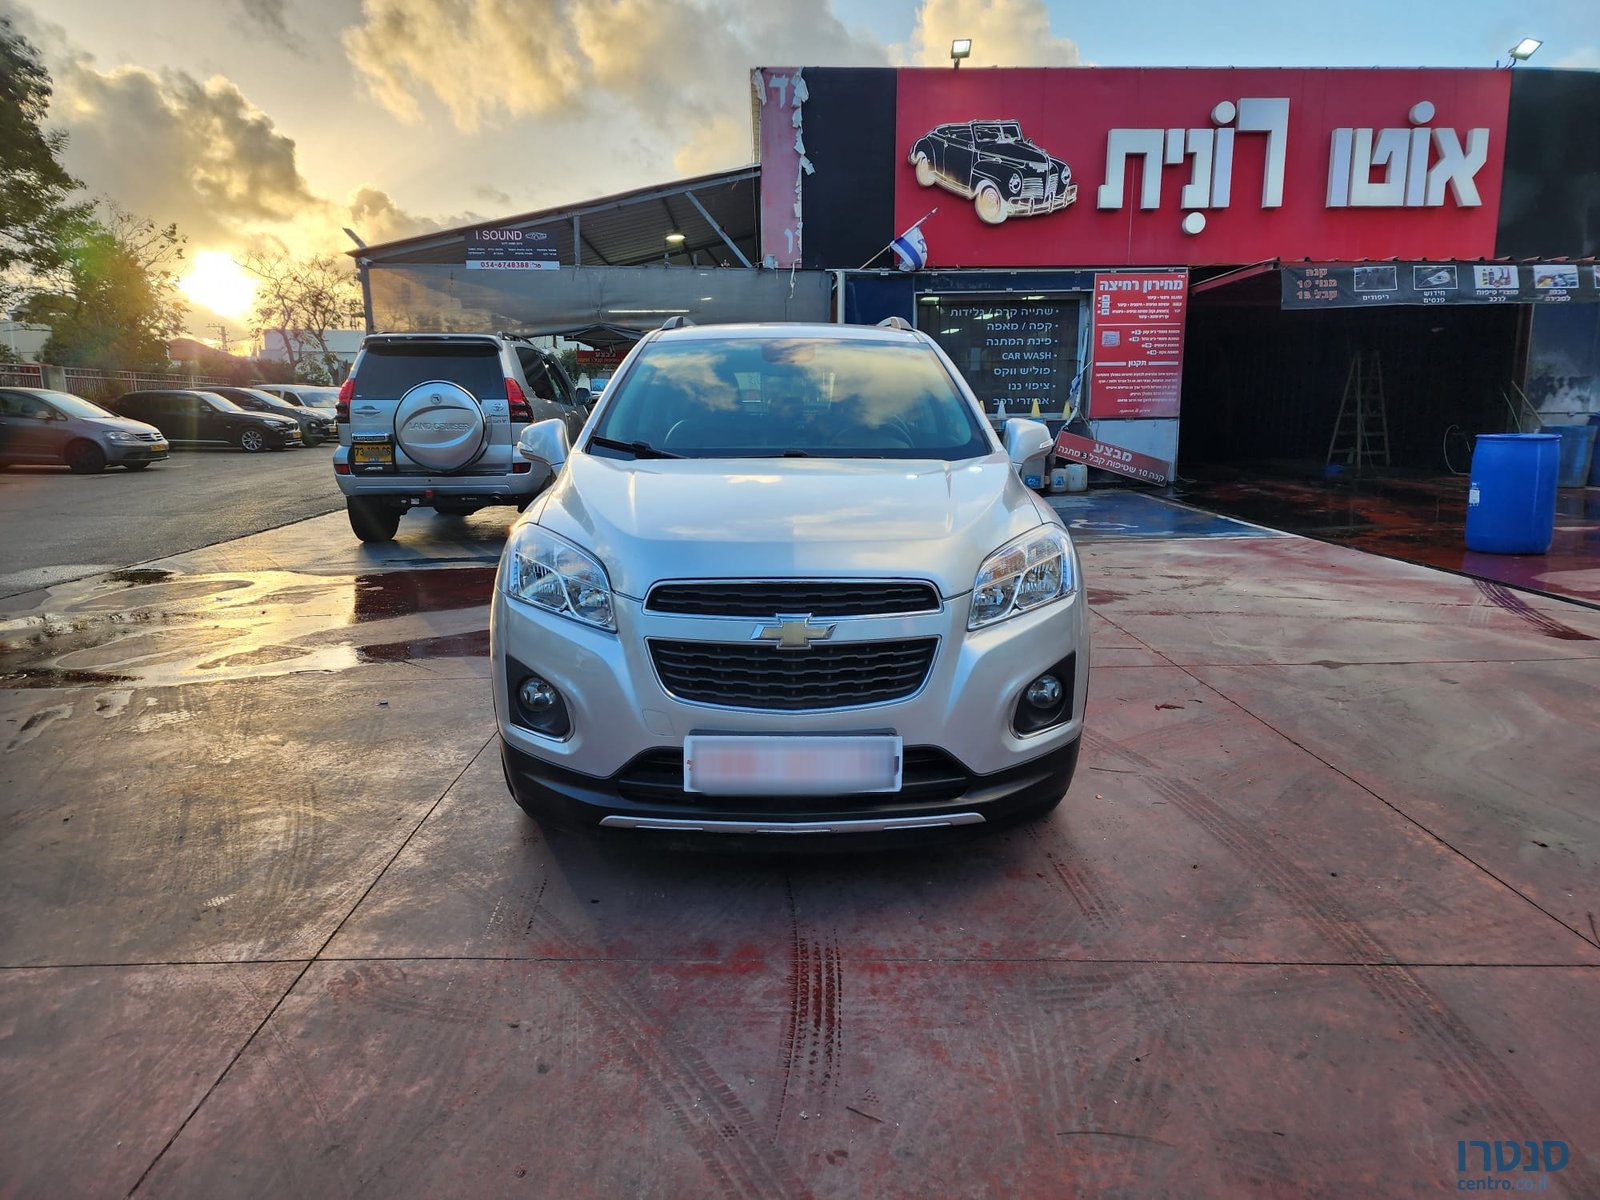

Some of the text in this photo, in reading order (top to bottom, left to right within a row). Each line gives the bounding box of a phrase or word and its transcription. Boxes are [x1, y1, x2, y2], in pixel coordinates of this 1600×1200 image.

[480, 261, 529, 269] 054-6748388
[1099, 280, 1183, 293] מחירון רחיצה
[1296, 279, 1312, 288] 10
[1029, 322, 1052, 331] קפה
[986, 338, 1024, 346] המתנה
[1002, 352, 1052, 360] CAR WASH
[993, 365, 1051, 376] פוליש ווקס
[1058, 445, 1081, 458] מתנה
[1081, 452, 1088, 460] 3
[1093, 443, 1133, 462] מבצע
[1089, 453, 1106, 466] קבל
[1139, 468, 1148, 477] 10
[1148, 471, 1165, 482] קנה
